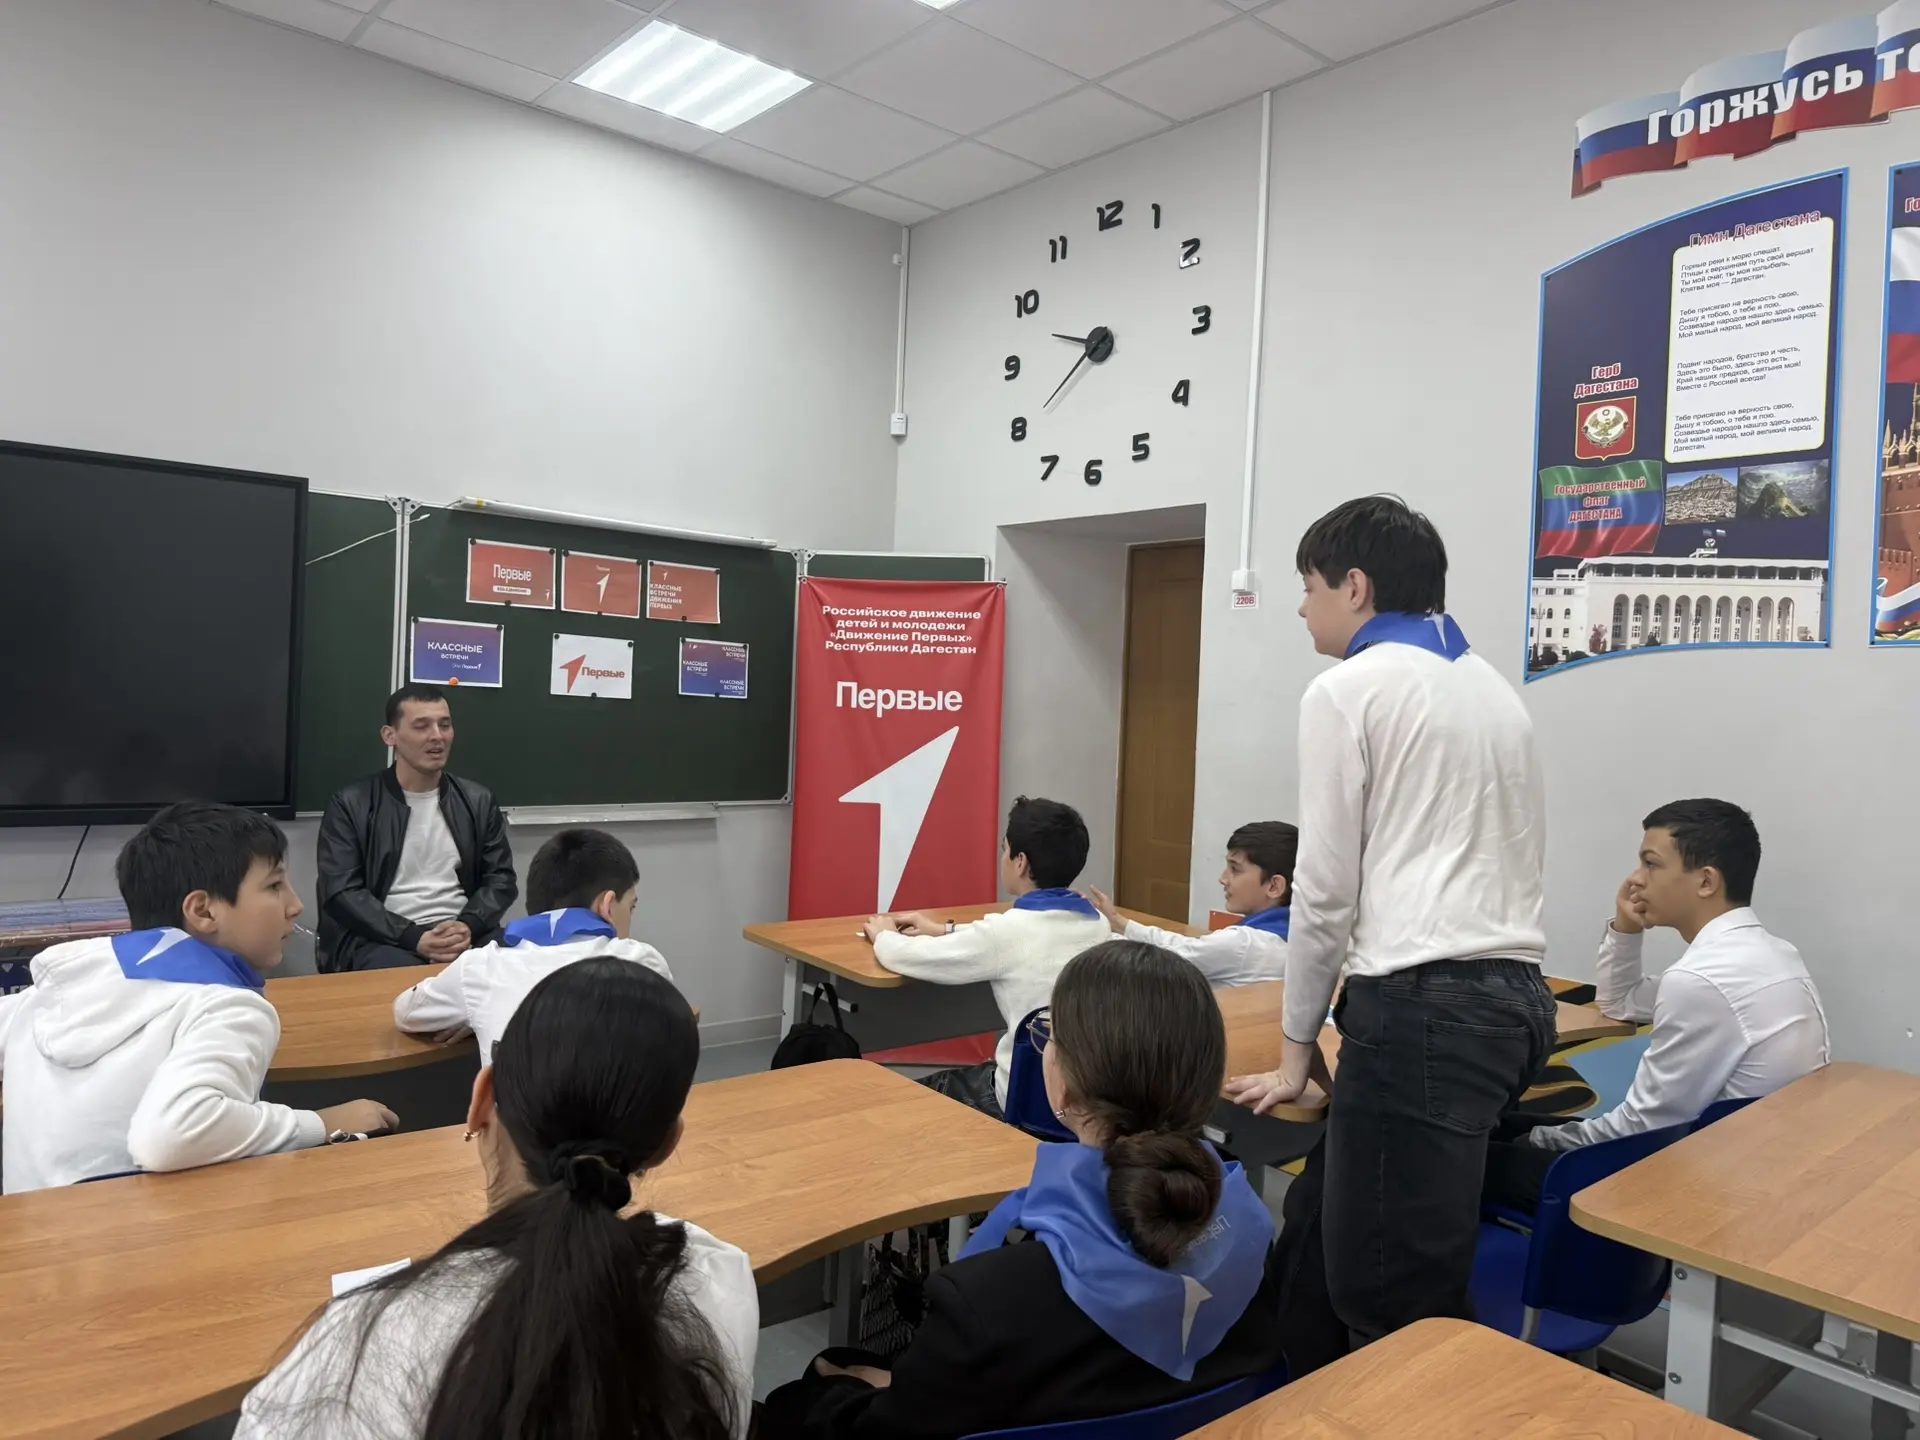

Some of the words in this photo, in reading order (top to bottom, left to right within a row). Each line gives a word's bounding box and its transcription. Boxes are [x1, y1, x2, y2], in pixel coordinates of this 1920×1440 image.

[1648, 63, 1863, 145] Горжусь
[1097, 200, 1123, 231] 12
[1152, 203, 1161, 229] 1
[1689, 229, 1729, 247] Гимн
[1733, 210, 1821, 241] Дагестана
[1049, 235, 1067, 263] 11
[1179, 237, 1200, 269] 2
[1015, 289, 1039, 318] 10
[1191, 305, 1211, 335] 3
[1004, 355, 1020, 380] 9
[1591, 363, 1621, 379] Герб
[1172, 379, 1190, 406] 4
[1574, 378, 1638, 398] Дагестана
[1011, 416, 1027, 442] 8
[1132, 432, 1150, 462] 5
[1040, 455, 1059, 481] 7
[1084, 459, 1103, 485] 6
[1554, 476, 1646, 496] Государственный
[1568, 507, 1622, 524] ДАГЕСТАНА
[493, 564, 532, 583] Первые
[649, 583, 682, 592] КЛАССНЫЕ
[649, 589, 676, 597] ВСТРЕЧИ
[649, 596, 682, 604] ДВИЖЕНИЯ
[649, 602, 673, 610] ПЕРВЫХ
[822, 605, 907, 618] Российское
[909, 610, 981, 619] движение
[836, 618, 879, 629] детей
[892, 623, 966, 632] молодежи
[428, 642, 483, 653] КЛАССНЫЕ
[825, 641, 908, 653] Республики
[911, 644, 976, 654] Дагестан
[830, 630, 909, 641] «Движение
[912, 632, 972, 643] Первых»
[581, 667, 625, 679] Первые
[836, 681, 962, 718] Первые
